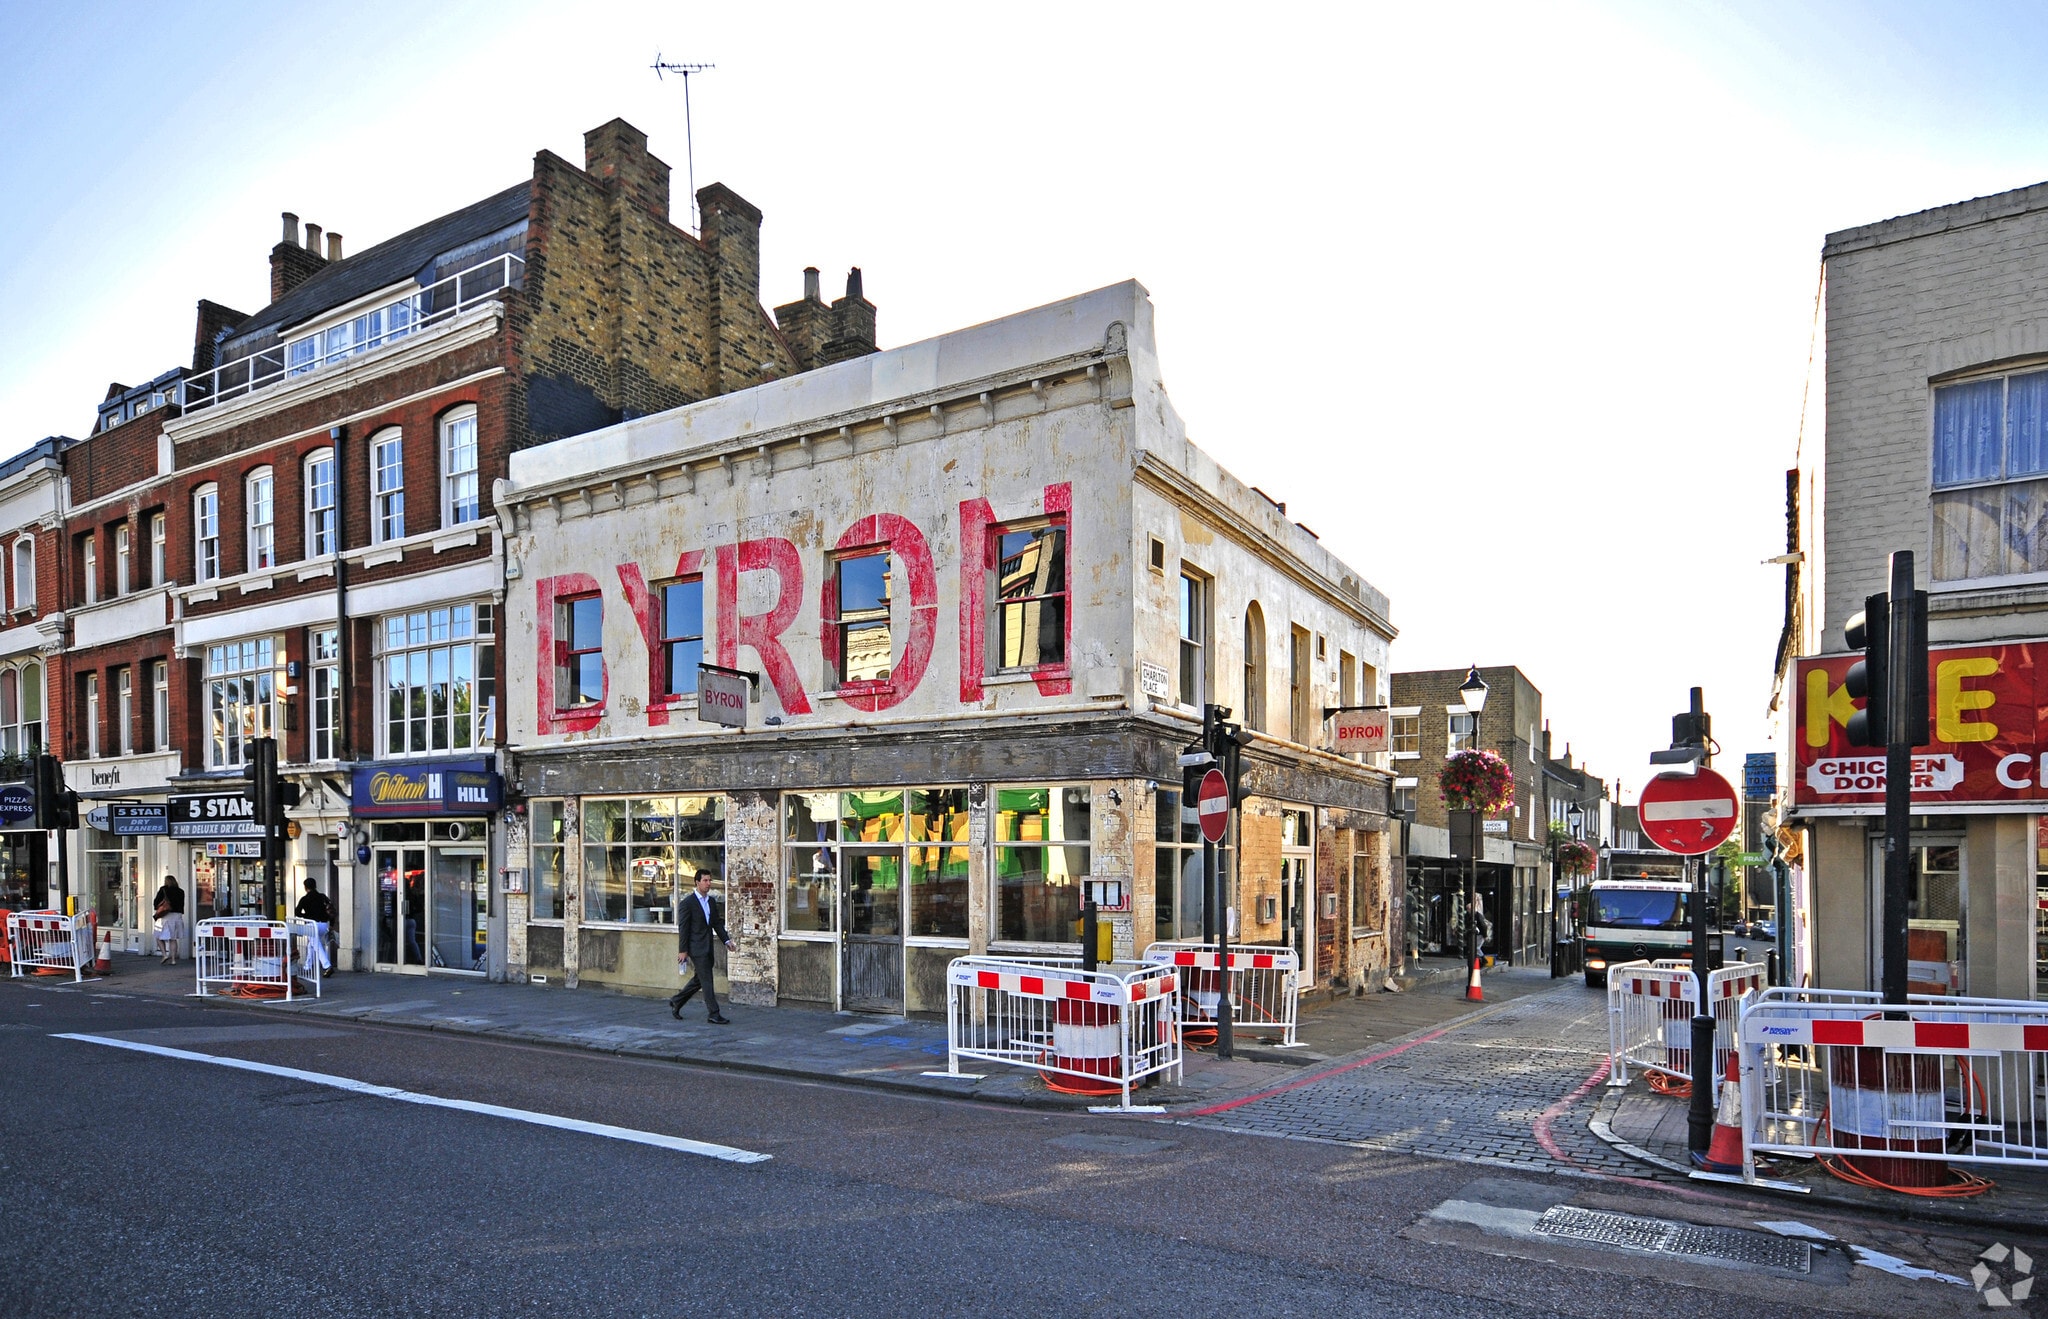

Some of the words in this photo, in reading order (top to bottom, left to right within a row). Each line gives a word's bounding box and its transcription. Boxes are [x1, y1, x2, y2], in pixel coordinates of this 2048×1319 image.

[536, 481, 1073, 736] BYRON
[1143, 668, 1168, 686] CHARLTON
[1143, 679, 1158, 694] PLACE
[705, 689, 743, 710] BYRON
[1339, 725, 1383, 739] BYRON
[1819, 758, 1946, 775] CHICEN
[91, 766, 121, 789] benefit
[1834, 774, 1934, 790] DONR
[370, 771, 429, 803] William
[457, 787, 488, 802] HILL
[4, 796, 27, 804] PIZZA
[189, 800, 201, 818] 5
[206, 798, 254, 817] STAR
[118, 808, 126, 816] 5
[128, 808, 162, 816] STAR
[173, 826, 179, 834] 2
[180, 825, 190, 834] HR
[192, 824, 219, 834] DELUXE
[220, 824, 236, 833] DRY
[234, 843, 249, 855] ALL
